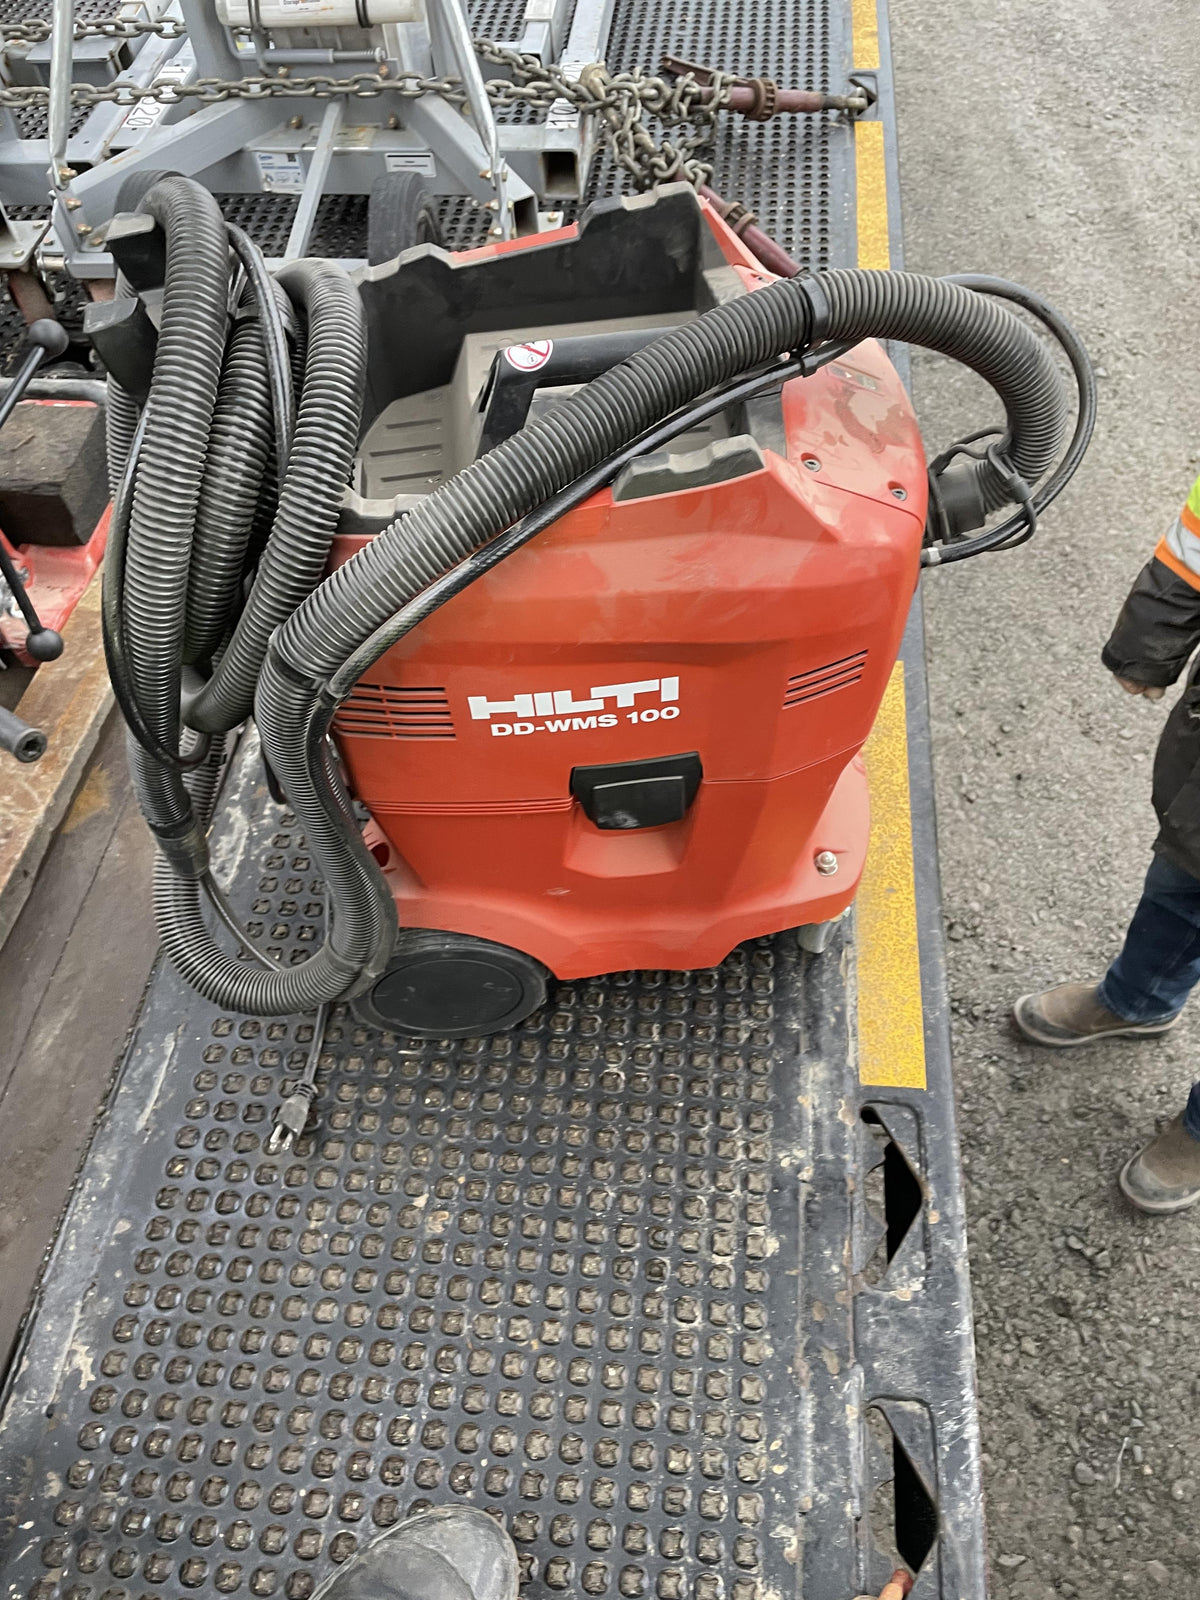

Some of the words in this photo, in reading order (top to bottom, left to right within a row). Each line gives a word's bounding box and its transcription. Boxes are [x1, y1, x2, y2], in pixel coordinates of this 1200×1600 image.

[467, 676, 680, 719] HILTI
[490, 714, 618, 736] DD-WMS
[626, 706, 681, 724] 100
